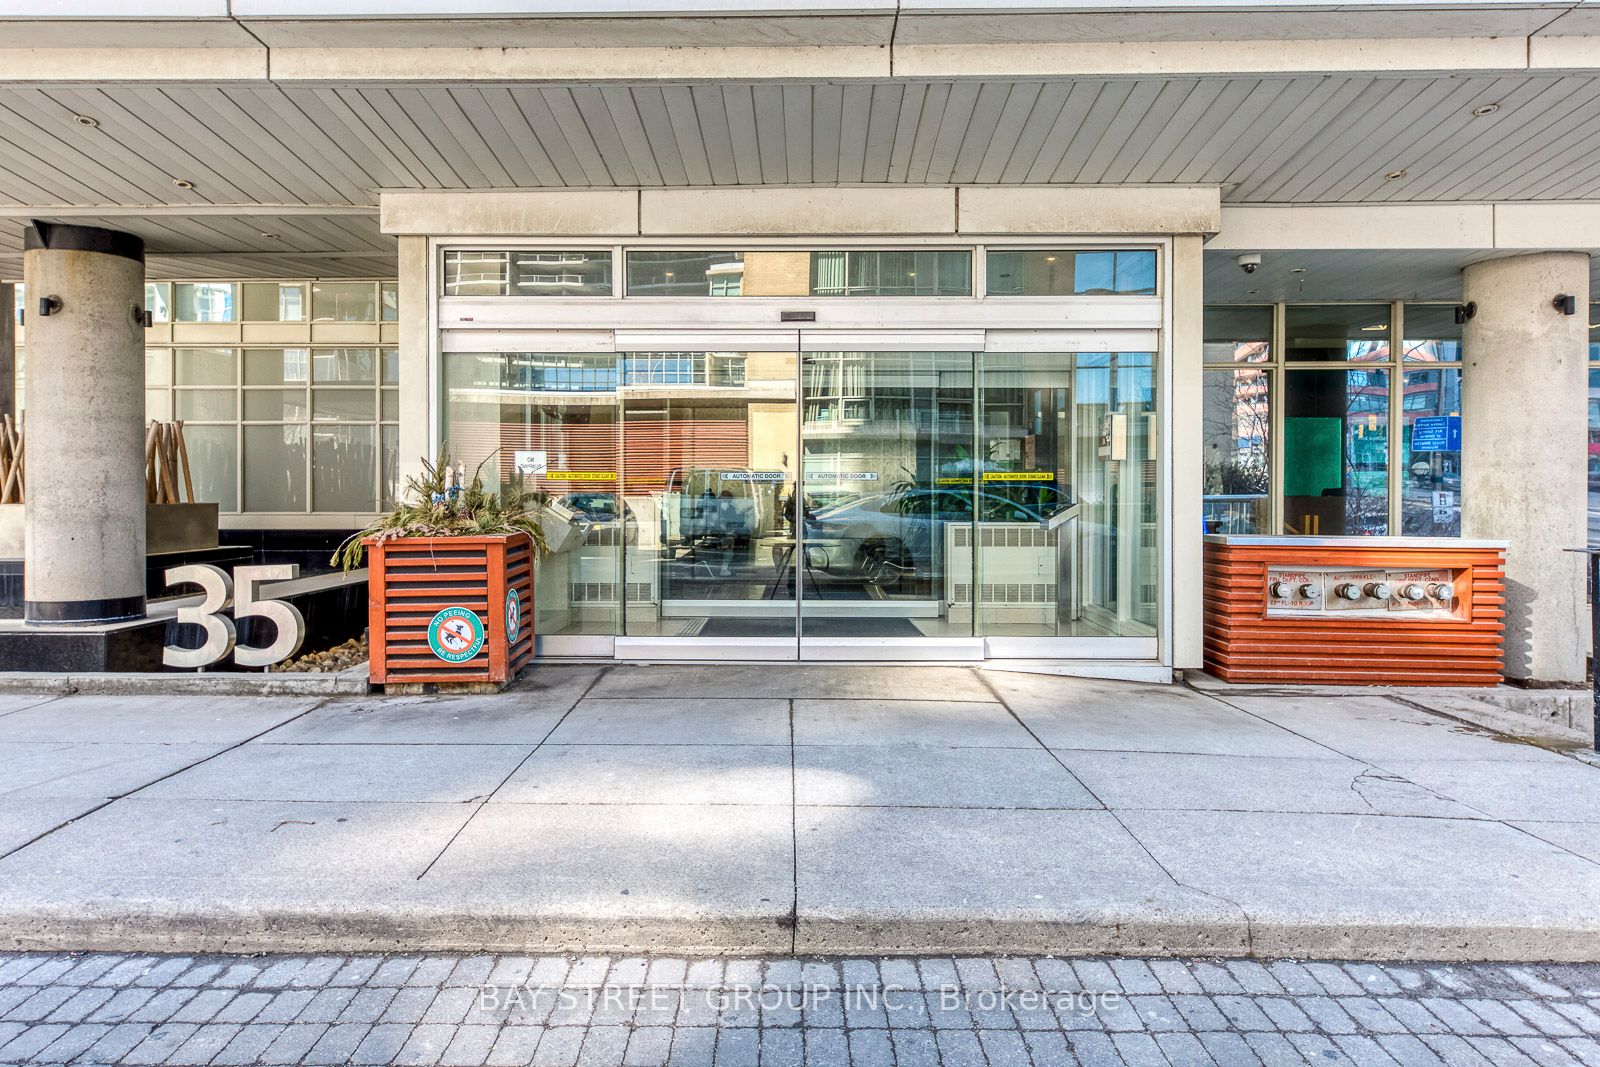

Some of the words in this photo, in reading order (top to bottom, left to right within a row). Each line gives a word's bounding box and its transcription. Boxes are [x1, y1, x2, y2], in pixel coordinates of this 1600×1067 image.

[163, 564, 305, 667] 35
[433, 616, 443, 627] NO
[443, 609, 471, 619] PEEING
[436, 647, 446, 657] BE
[446, 636, 482, 660] RESPECTFUL
